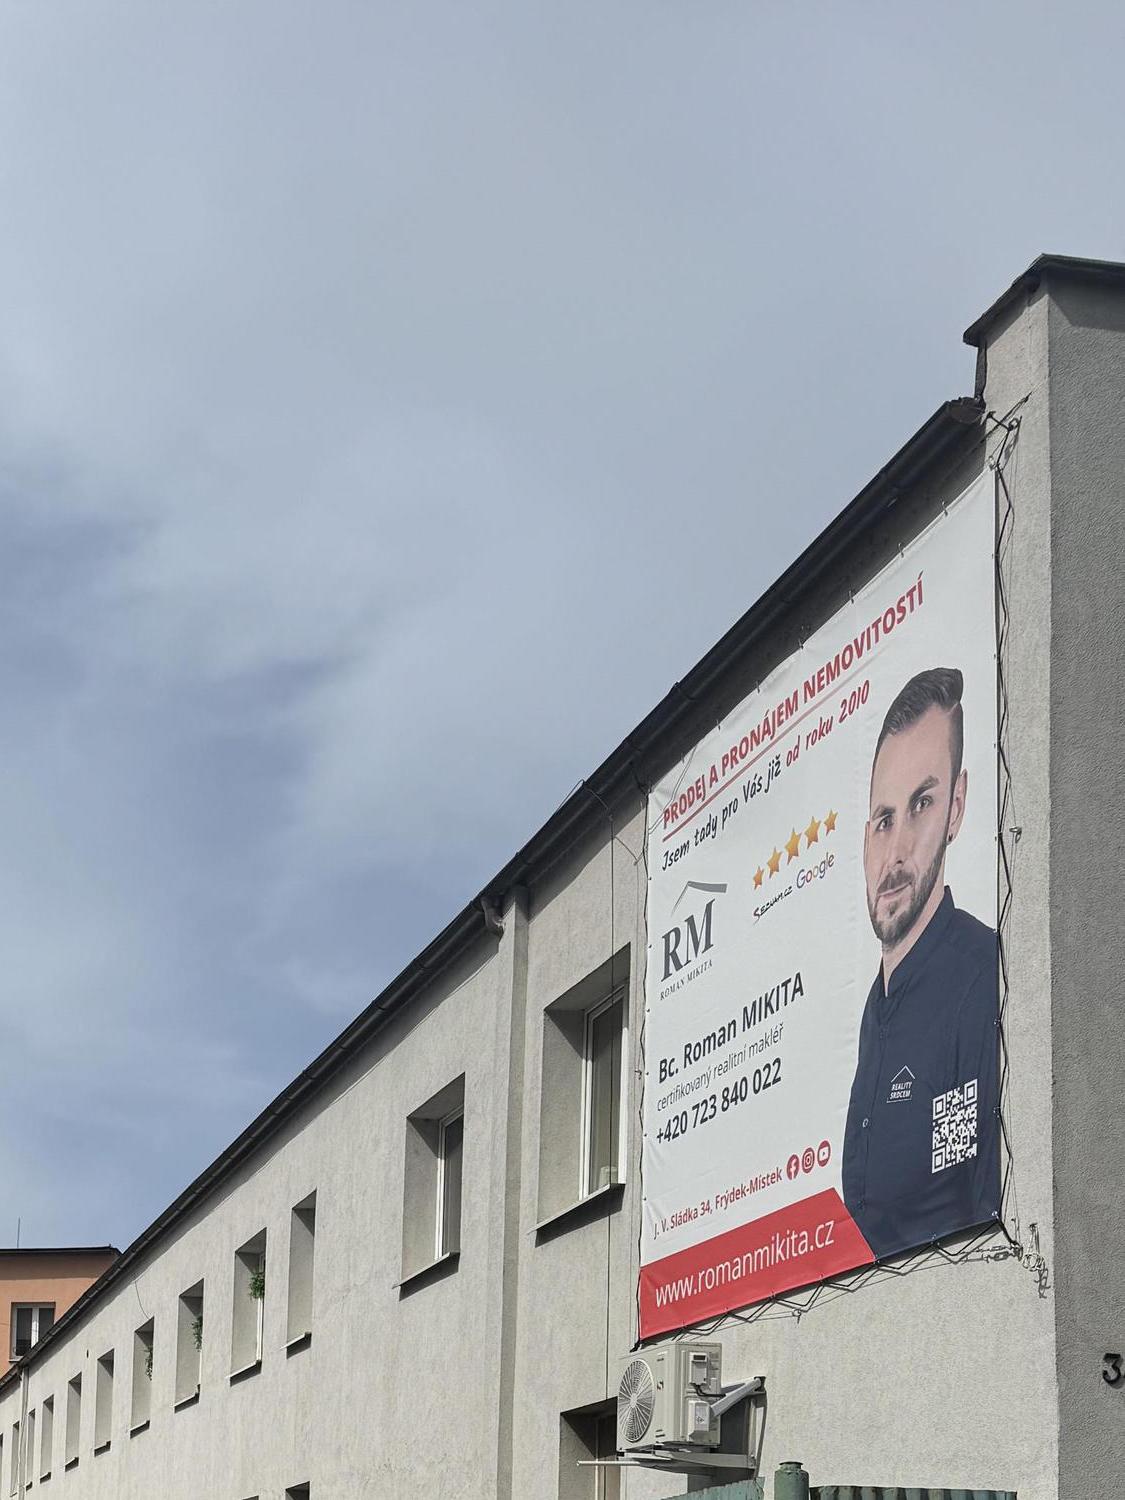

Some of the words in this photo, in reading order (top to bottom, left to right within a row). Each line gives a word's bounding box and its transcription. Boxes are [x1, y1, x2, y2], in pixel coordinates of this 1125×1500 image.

[663, 774, 706, 829] PRODEJ
[709, 765, 718, 788] A
[722, 690, 799, 777] PRONÁJEM
[803, 570, 924, 704] NEMOVITOSTÍ
[662, 840, 689, 871] Jsem
[694, 814, 717, 847] tady
[722, 798, 738, 830] pro
[743, 773, 762, 803] Vás
[765, 754, 781, 793] již
[786, 735, 801, 767] od
[806, 716, 834, 750] roku
[839, 679, 870, 724] 2010
[796, 851, 835, 889] Google
[660, 980, 684, 1001] ROMAN
[687, 959, 713, 982] MIKITA
[661, 898, 715, 982] RM
[657, 1066, 711, 1111] certifikovaný
[714, 1044, 746, 1080] realitní
[748, 1022, 784, 1059] makléř
[659, 1058, 679, 1084] Bc.
[683, 1019, 737, 1069] Roman
[742, 972, 805, 1032] MIKITA
[656, 1110, 688, 1144] +420
[691, 1094, 717, 1129] 723
[721, 1077, 748, 1112] 840
[752, 1057, 782, 1094] 022
[891, 1081, 912, 1091] REALITY
[653, 1223, 660, 1240] J.
[661, 1219, 669, 1233] V.
[670, 1205, 698, 1230] Sládka
[700, 1200, 713, 1217] 34,
[715, 1166, 783, 1210] Frýdek-Místek
[655, 1220, 835, 1308] www.romanmikita.cz
